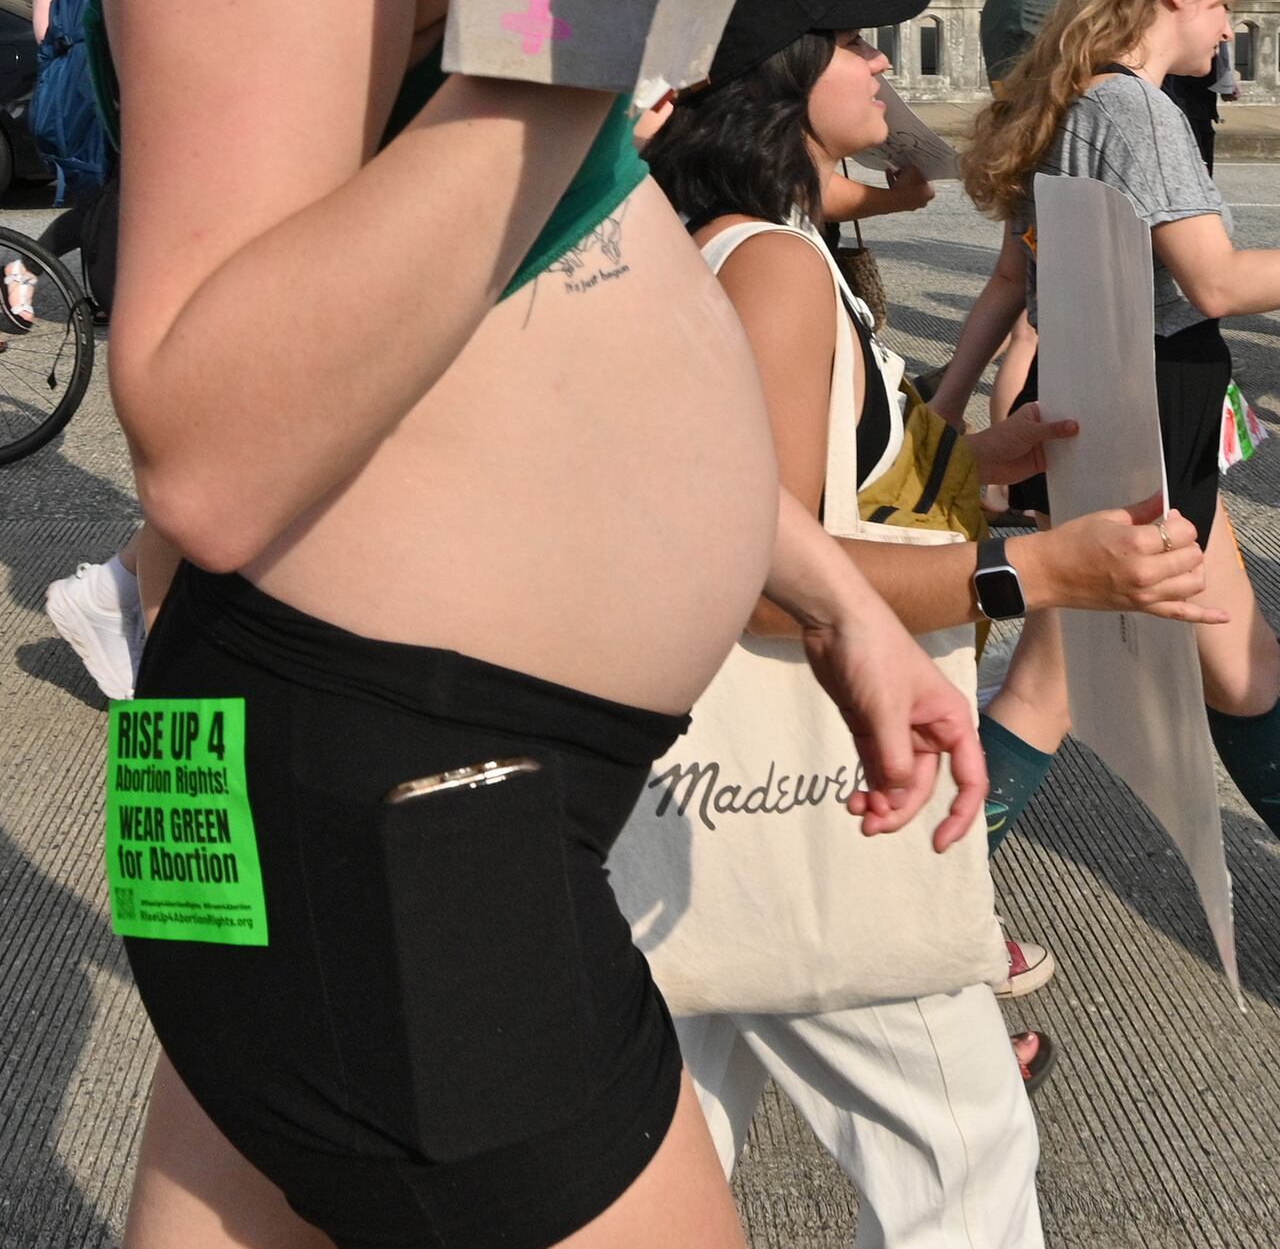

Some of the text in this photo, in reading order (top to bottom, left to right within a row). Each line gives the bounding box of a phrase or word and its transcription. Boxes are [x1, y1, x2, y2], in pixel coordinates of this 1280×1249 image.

[118, 711, 225, 761] RISE UP 4
[116, 764, 229, 797] Abortion Rights!
[119, 805, 232, 843] WEAR GREEN
[118, 845, 239, 883] for Abortion
